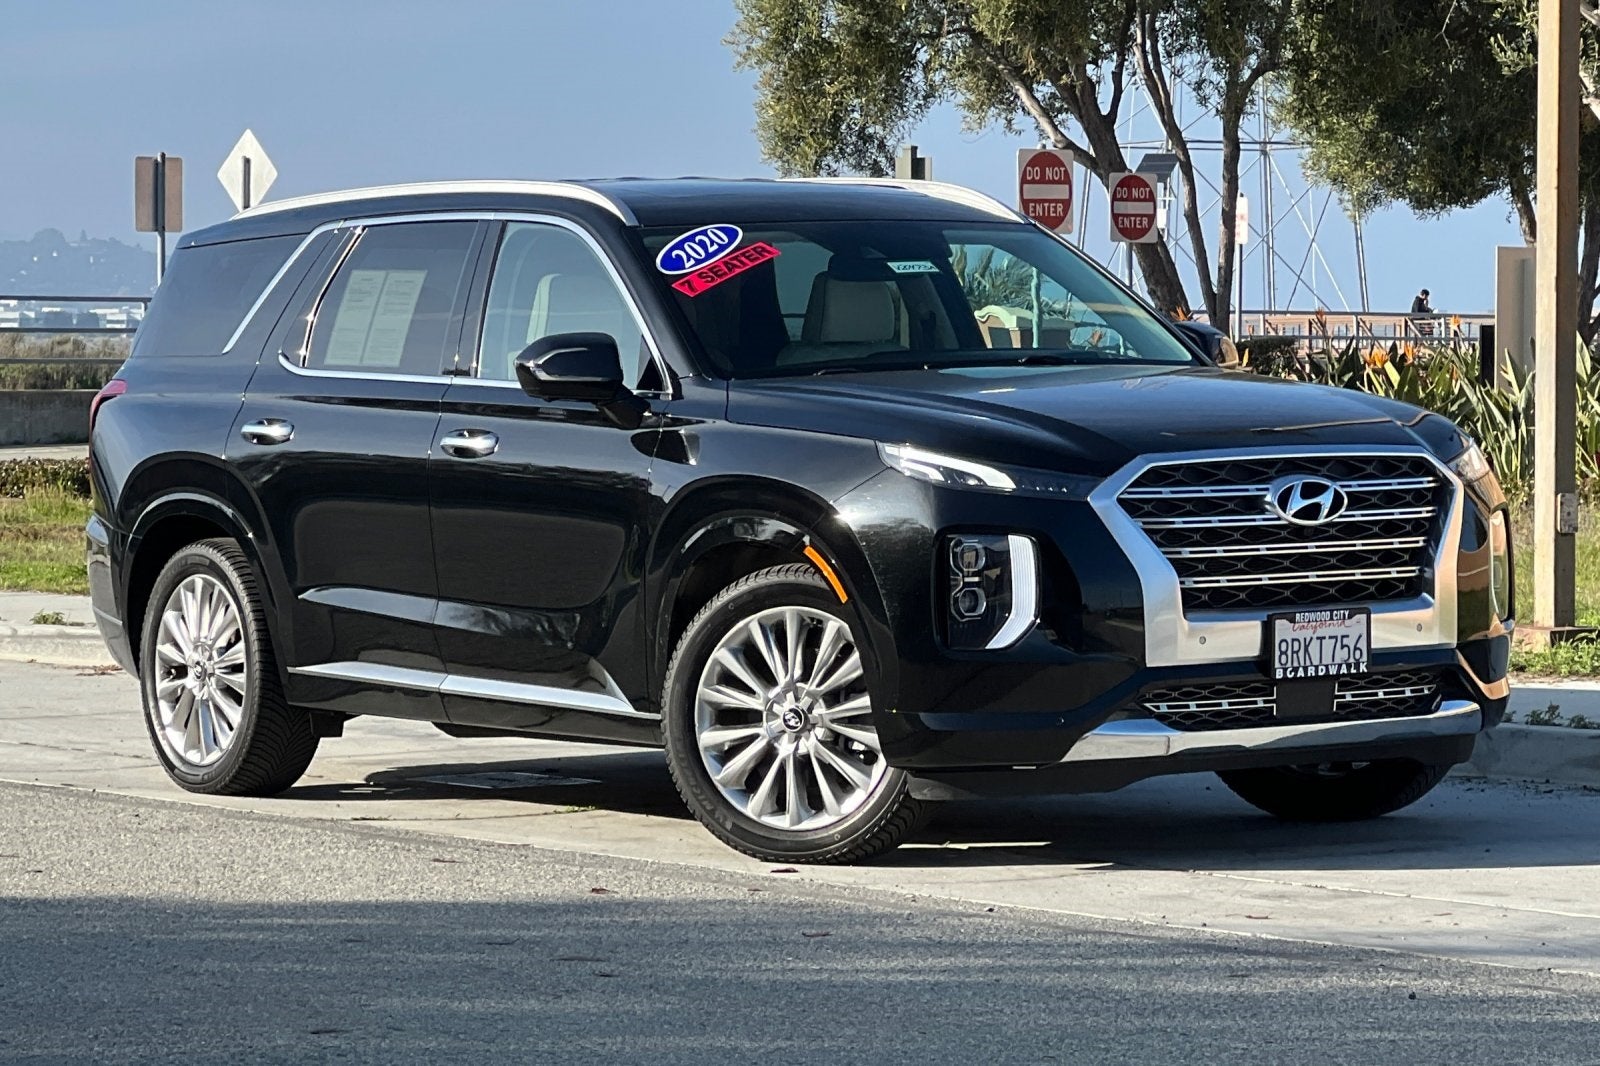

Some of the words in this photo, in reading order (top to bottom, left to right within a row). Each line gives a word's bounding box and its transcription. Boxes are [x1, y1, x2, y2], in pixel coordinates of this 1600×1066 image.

[1026, 166, 1040, 181] DO
[1045, 166, 1066, 181] NOT
[1116, 187, 1128, 199] DO
[1132, 187, 1150, 199] NOT
[1029, 202, 1064, 217] ENTER
[1118, 216, 1149, 229] ENTER
[671, 228, 729, 269] 2020
[680, 279, 697, 293] 7
[697, 246, 772, 284] SEATER
[1295, 611, 1331, 623] REDWOOD
[1333, 609, 1350, 620] CITY
[1278, 633, 1363, 667] 8RKT756
[1275, 662, 1368, 679] BOARDWALK
